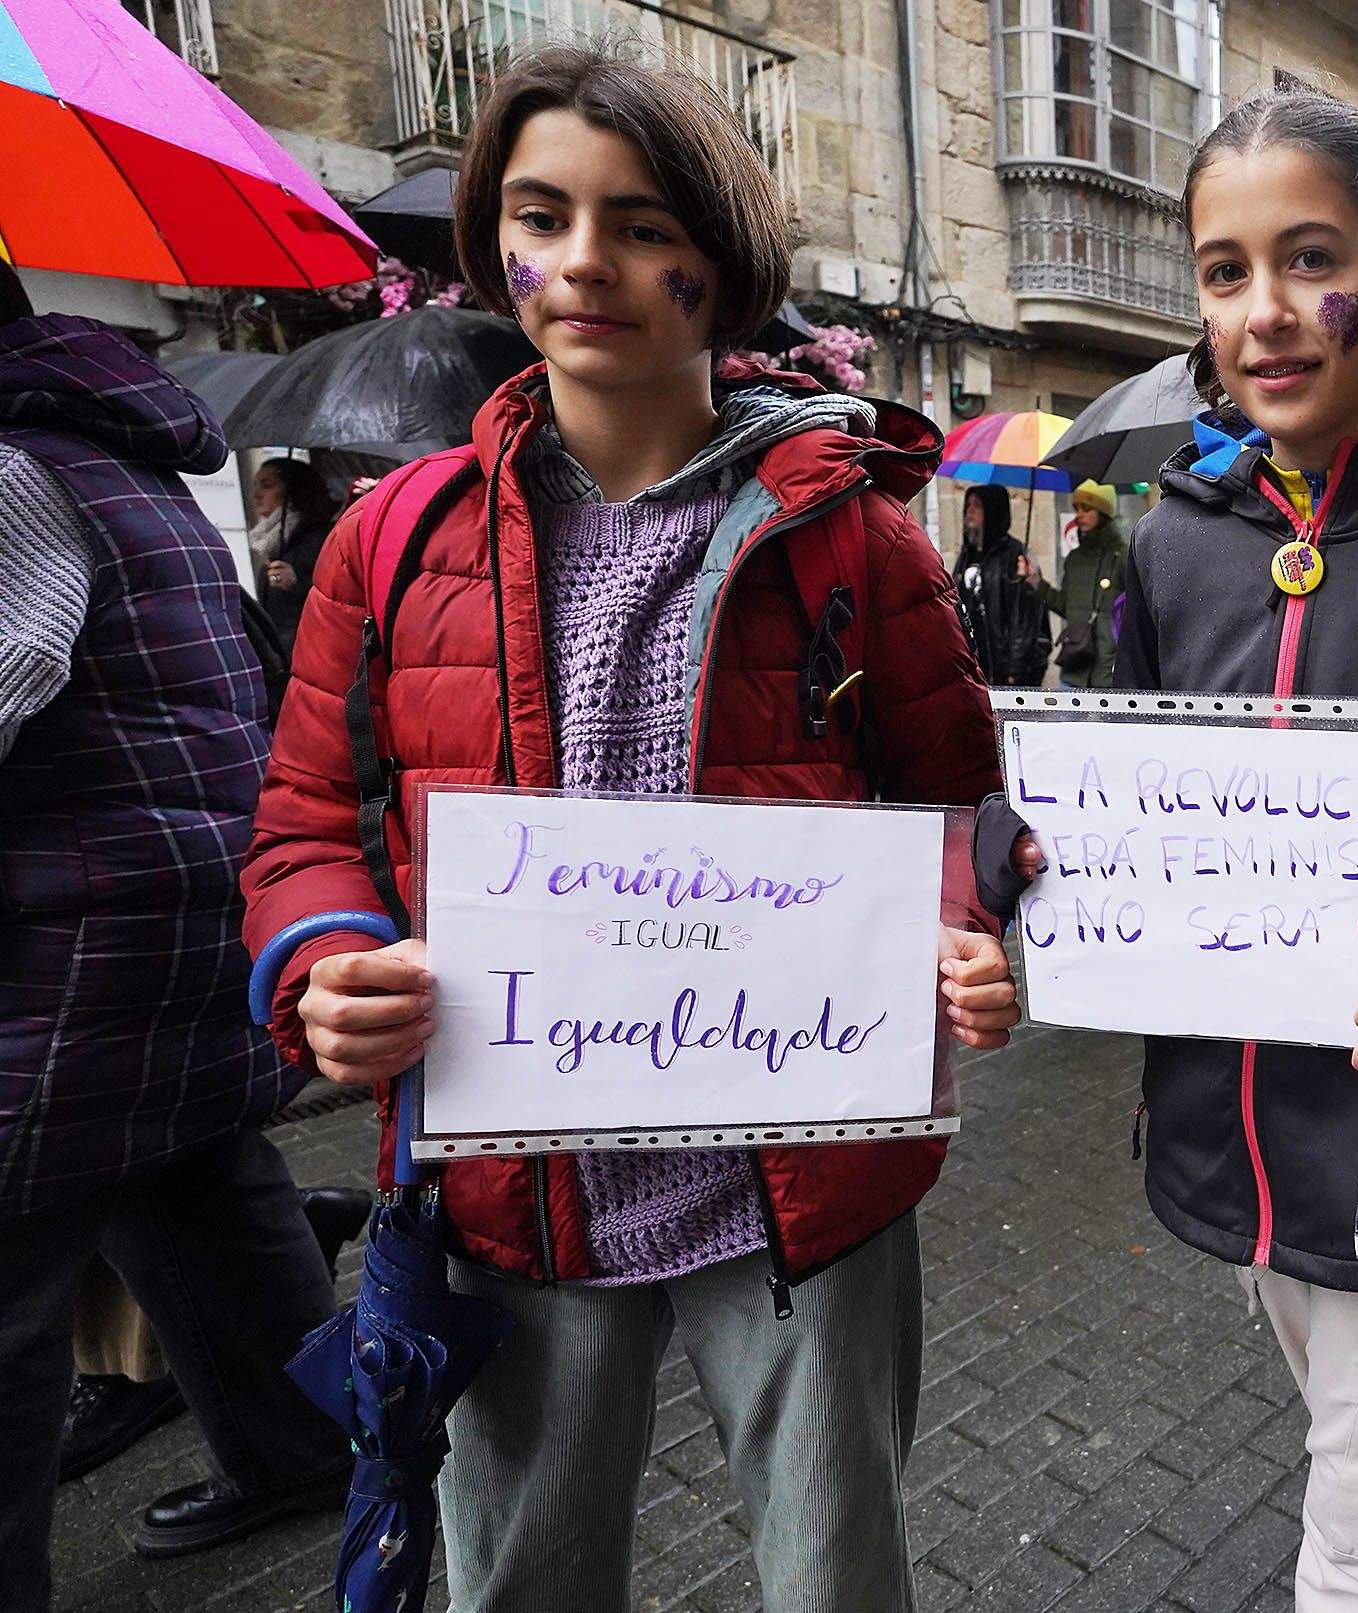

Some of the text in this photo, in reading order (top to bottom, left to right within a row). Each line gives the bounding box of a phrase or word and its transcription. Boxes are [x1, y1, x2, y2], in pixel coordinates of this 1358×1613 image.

[486, 820, 845, 909] Feminismo
[610, 918, 730, 951] IGUAL
[487, 969, 888, 1074] Igualdade
